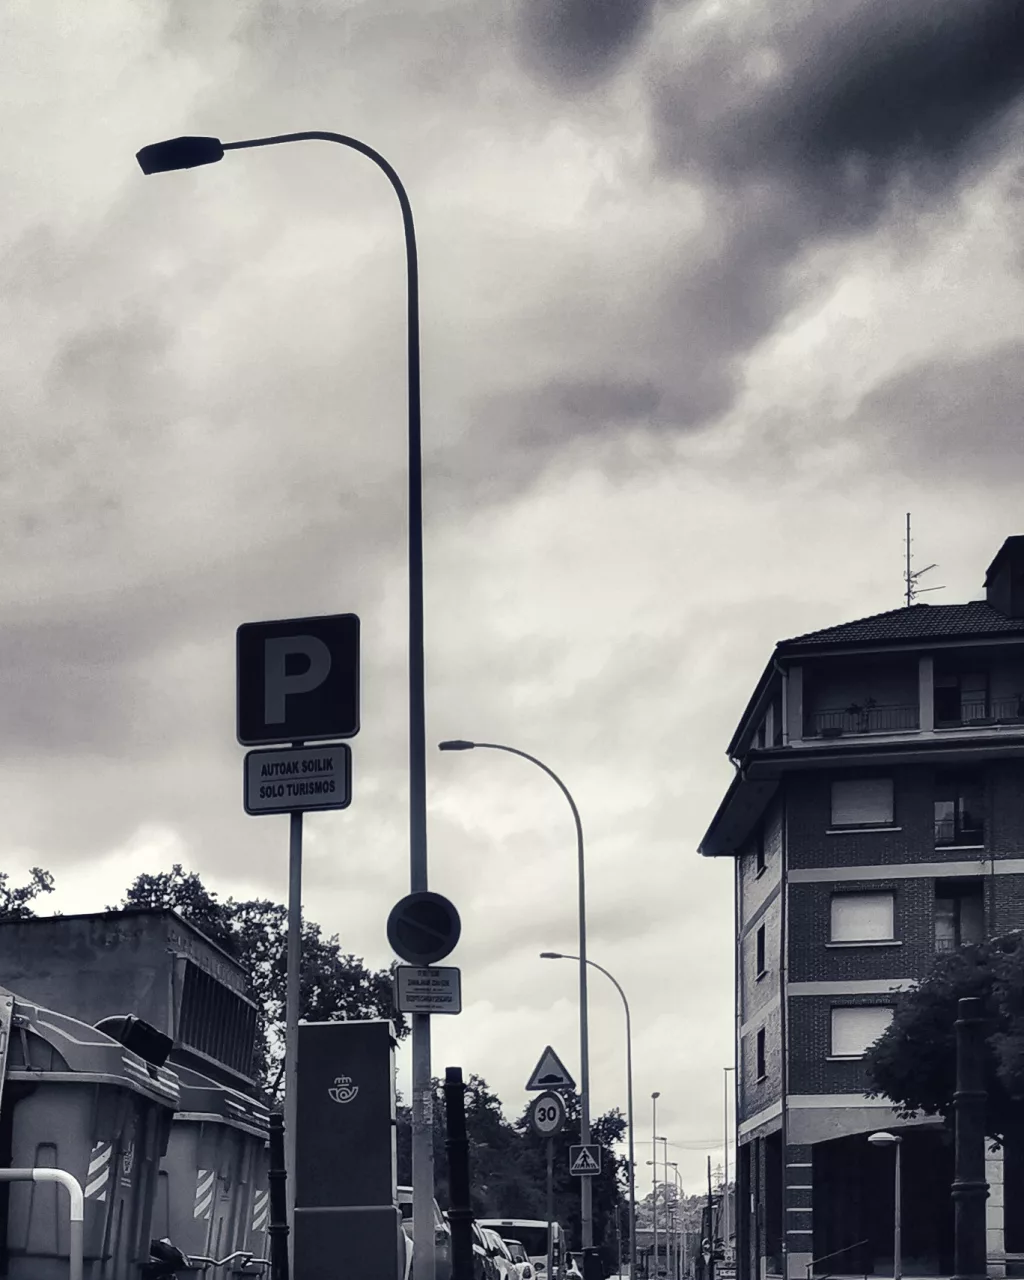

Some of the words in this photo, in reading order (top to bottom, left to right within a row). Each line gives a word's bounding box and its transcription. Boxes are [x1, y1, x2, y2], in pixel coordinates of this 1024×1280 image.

[264, 635, 332, 725] P
[260, 761, 299, 777] AUTOAK
[302, 757, 334, 773] SOILIK
[260, 784, 284, 799] SOLO
[286, 780, 336, 797] TURISMOS
[538, 1106, 557, 1122] 30
